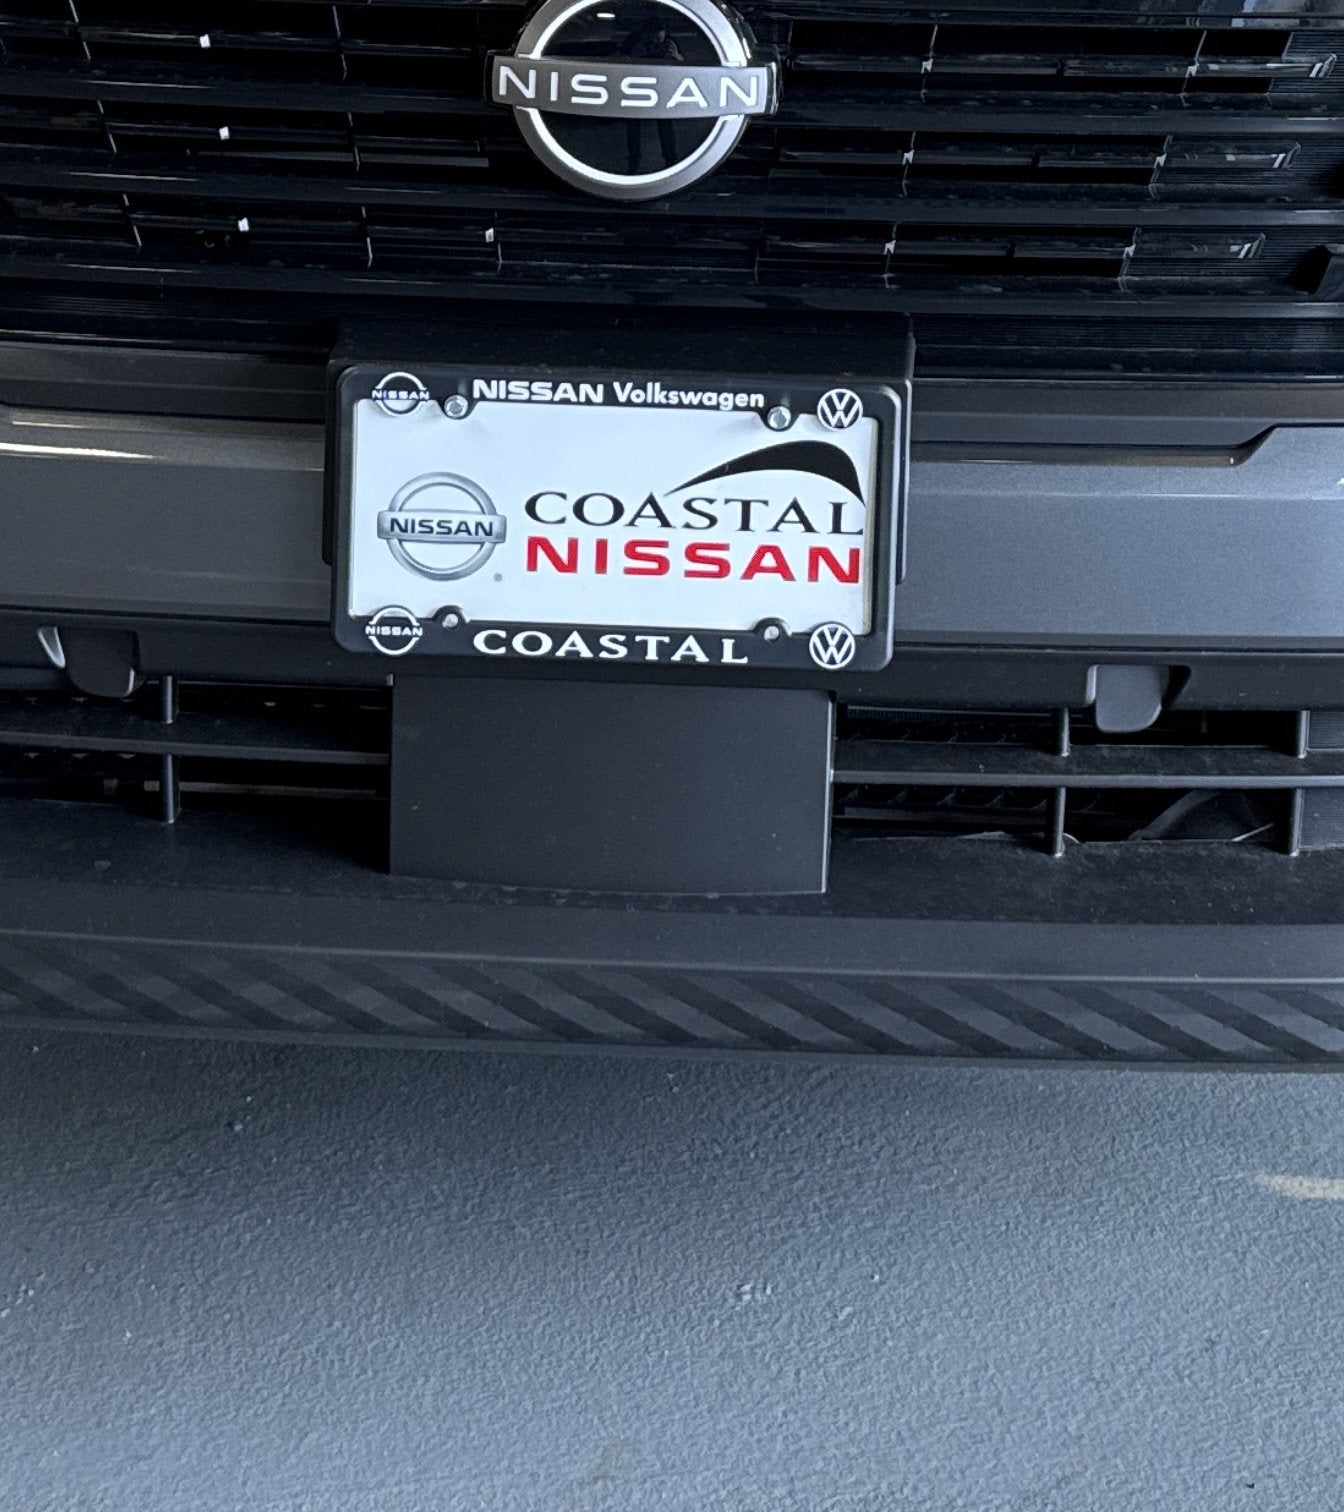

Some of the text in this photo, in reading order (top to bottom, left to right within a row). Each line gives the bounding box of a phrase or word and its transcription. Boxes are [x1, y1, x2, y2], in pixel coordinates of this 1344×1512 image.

[499, 66, 758, 108] NISSAN
[371, 390, 430, 401] NISSAN
[473, 378, 765, 410] NISSAN Volkswagen
[389, 516, 494, 537] NISSAN
[524, 491, 865, 536] COASTAL
[525, 536, 861, 584] NISSAN
[365, 625, 423, 637] NISSAN
[473, 629, 749, 664] COASTAL
